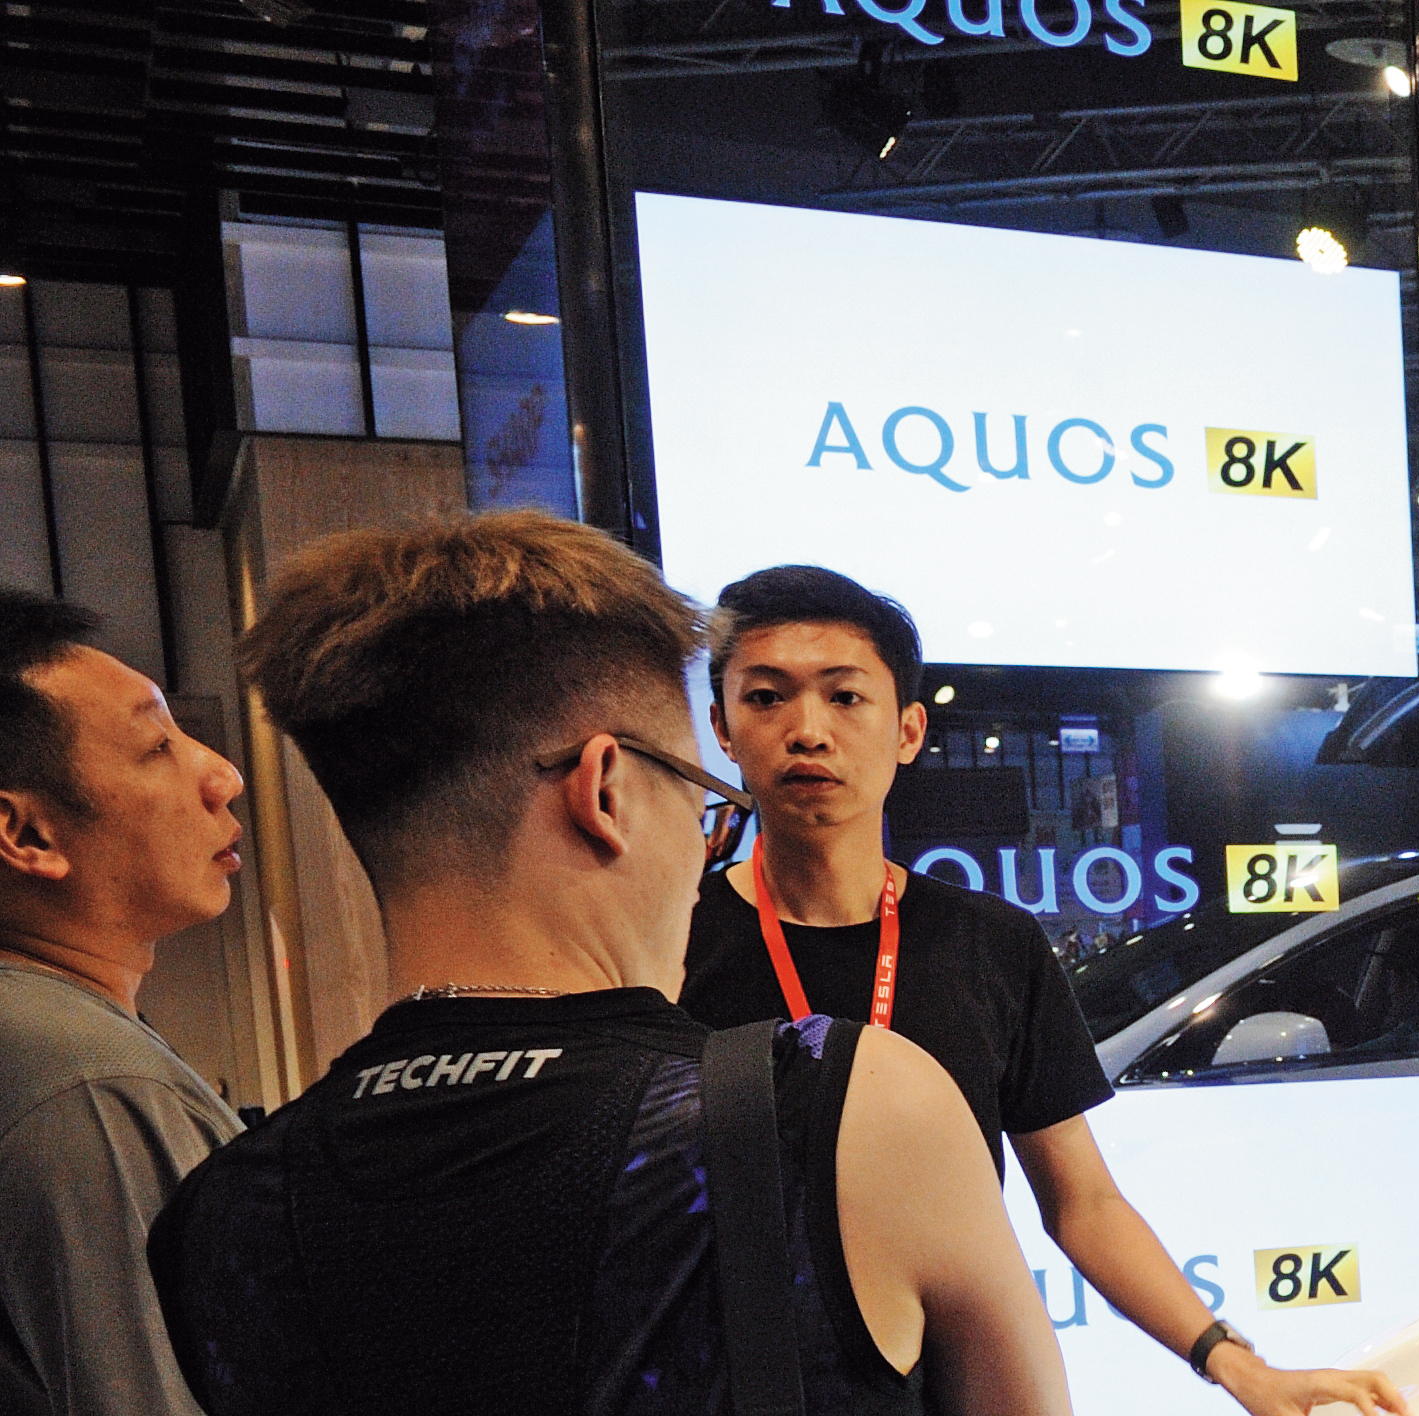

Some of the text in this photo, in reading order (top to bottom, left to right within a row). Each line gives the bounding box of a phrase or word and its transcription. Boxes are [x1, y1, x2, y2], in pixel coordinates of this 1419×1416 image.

[1196, 8, 1286, 69] 8K
[806, 402, 1306, 492] AQUOS 8K
[1242, 853, 1327, 905] 8K
[874, 954, 893, 1027] TESLA
[353, 1047, 563, 1100] TECHFIT
[1267, 1251, 1357, 1303] 8K
